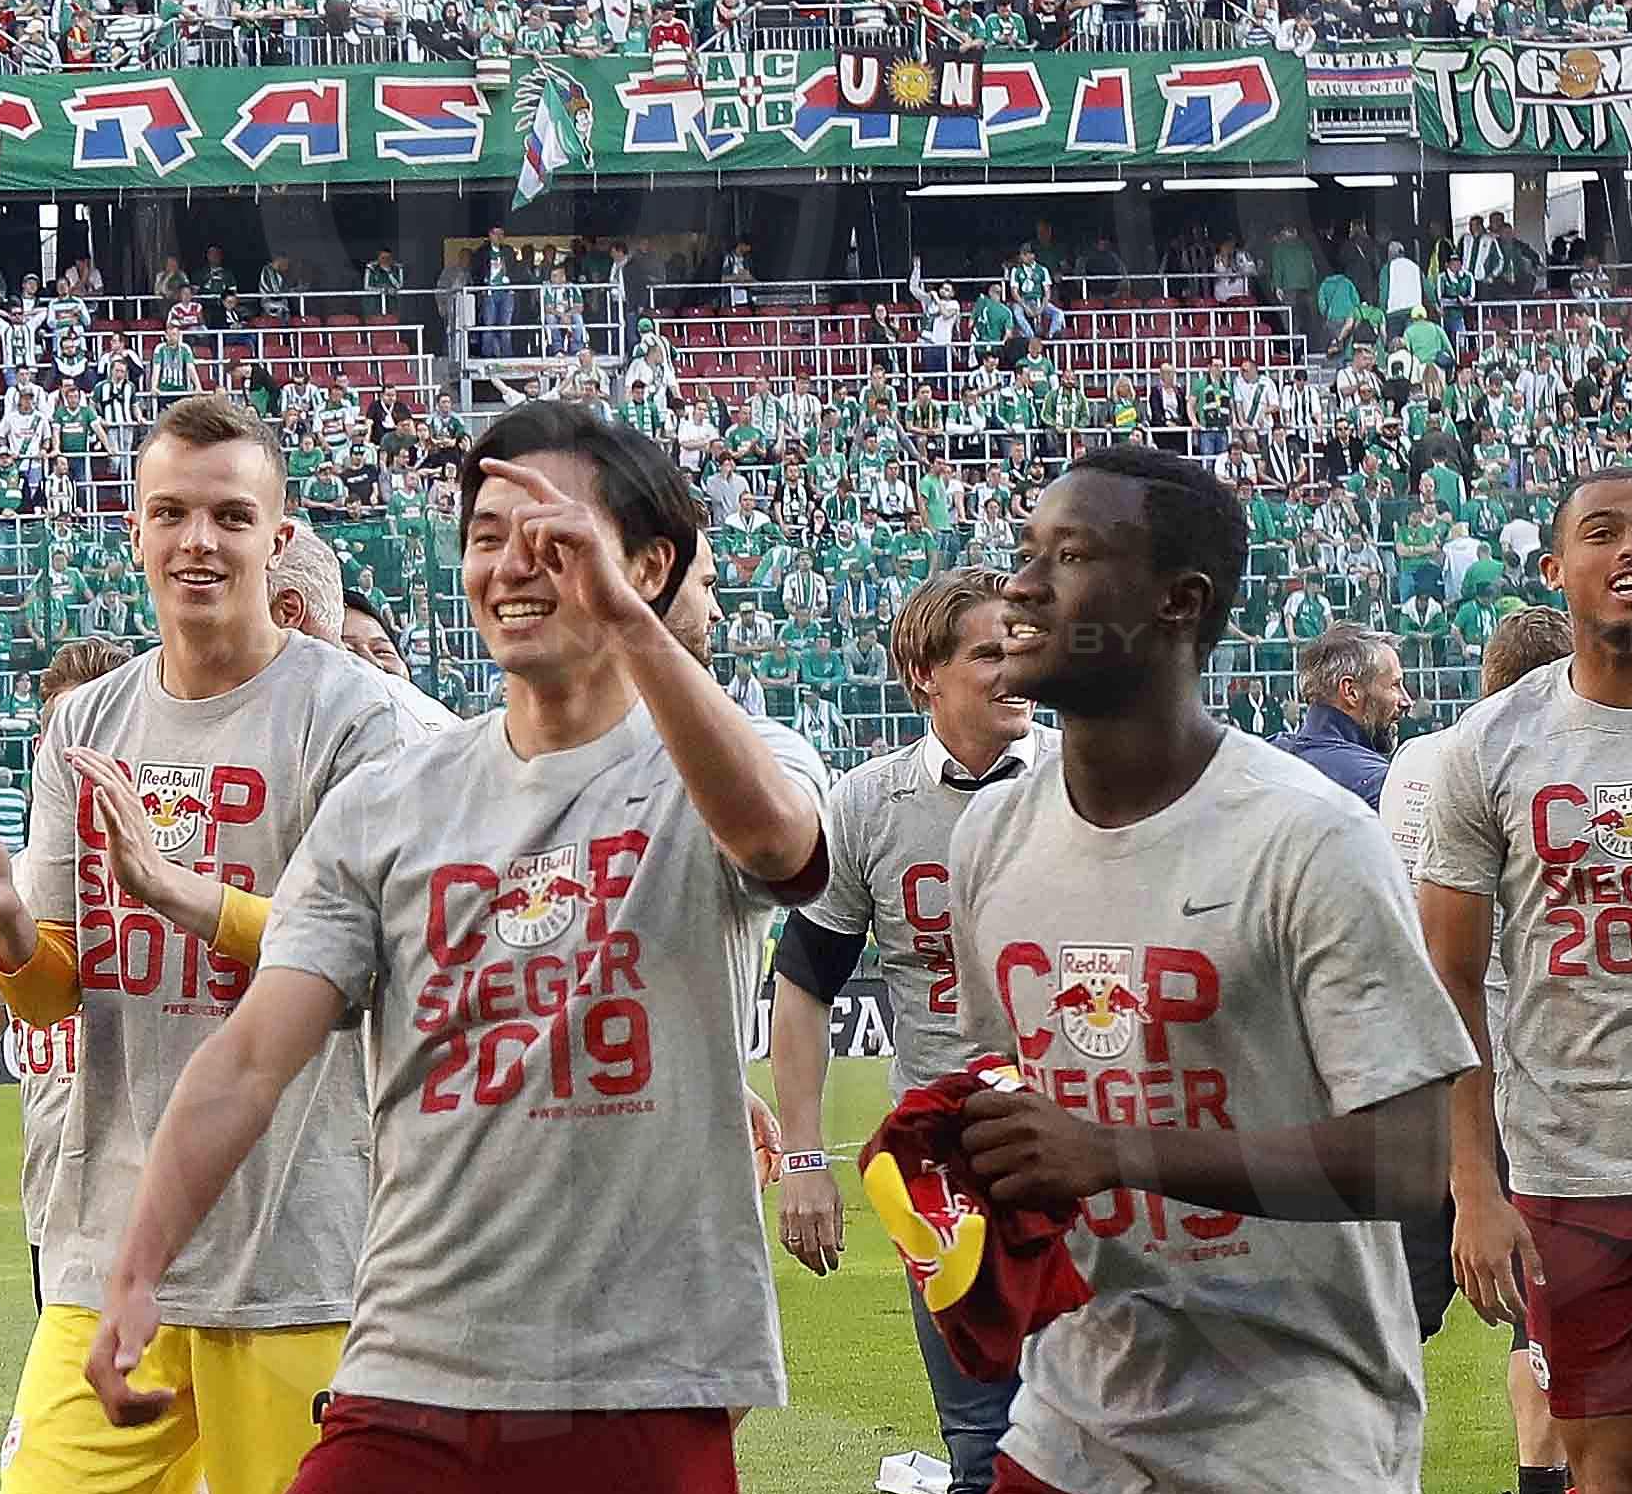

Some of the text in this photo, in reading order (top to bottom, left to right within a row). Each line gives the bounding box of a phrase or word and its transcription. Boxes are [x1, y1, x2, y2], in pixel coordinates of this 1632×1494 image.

[78, 765, 267, 858] CP
[1598, 787, 1623, 804] Red
[428, 830, 654, 969] CP
[539, 848, 574, 872] Bull
[996, 942, 1221, 1063] CP
[421, 997, 654, 1113] 2019
